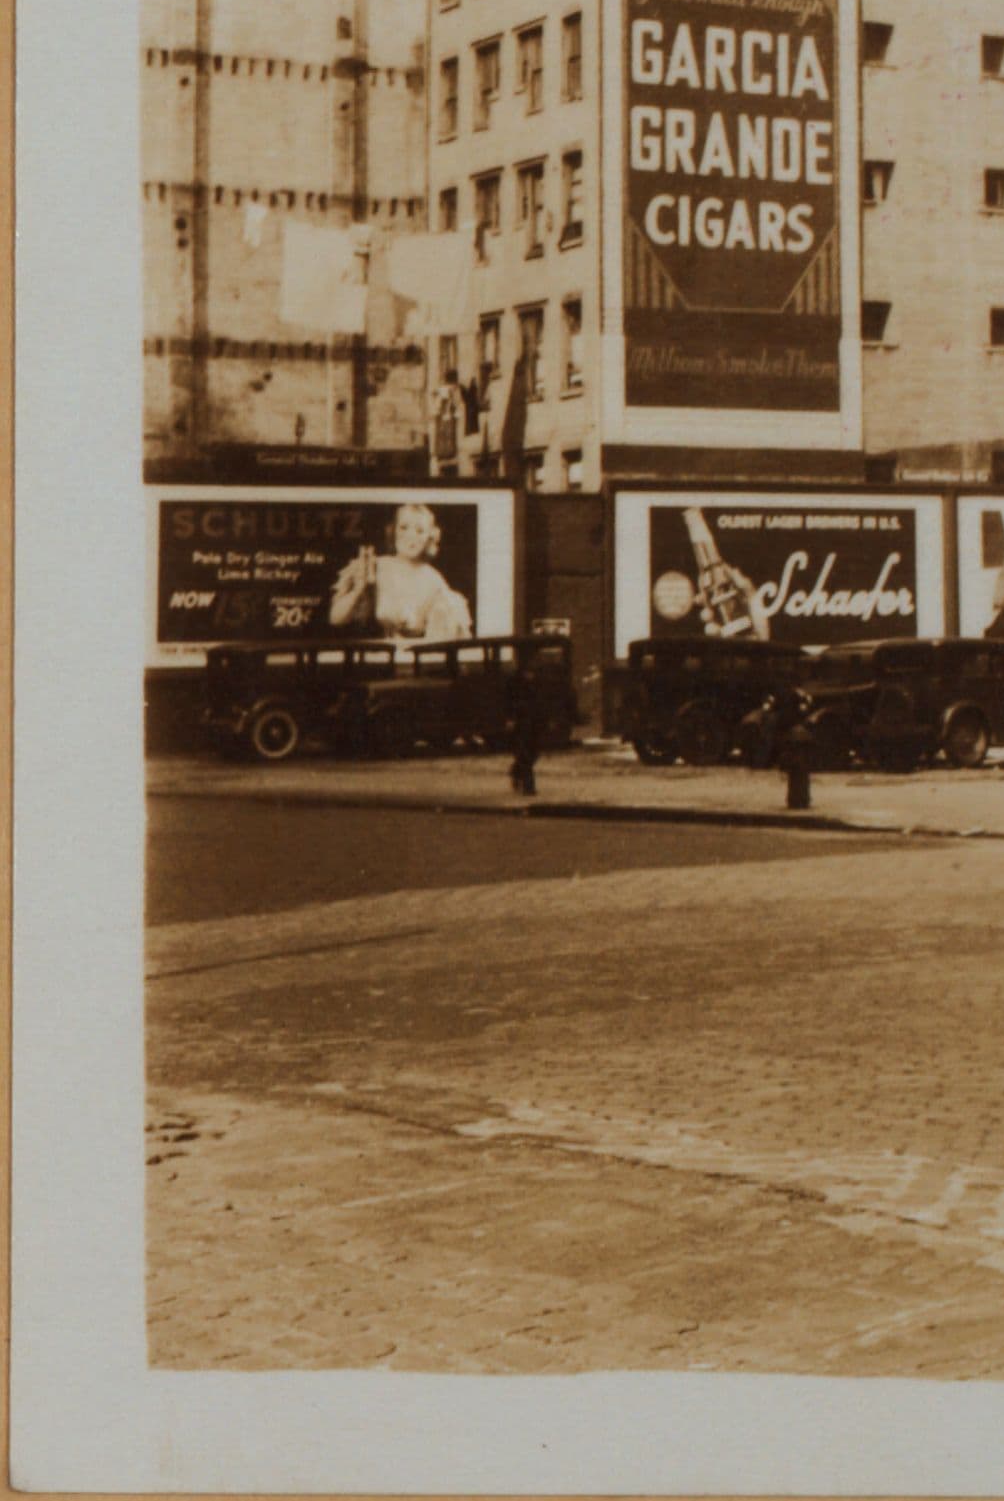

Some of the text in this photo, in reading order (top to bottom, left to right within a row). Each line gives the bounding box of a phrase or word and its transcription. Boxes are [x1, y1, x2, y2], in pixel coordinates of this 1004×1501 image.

[630, 18, 831, 102] GARCIA
[630, 103, 834, 186] GRANDE
[643, 194, 816, 253] CIGARS
[172, 508, 364, 540] SCHULTZ
[717, 513, 763, 530] OLDEST
[765, 514, 803, 530] LAGER
[191, 549, 325, 569] Pale Dry Ginger Ale
[217, 568, 250, 581] Lime
[169, 590, 217, 609] NOW
[757, 549, 915, 623] Schaefer
